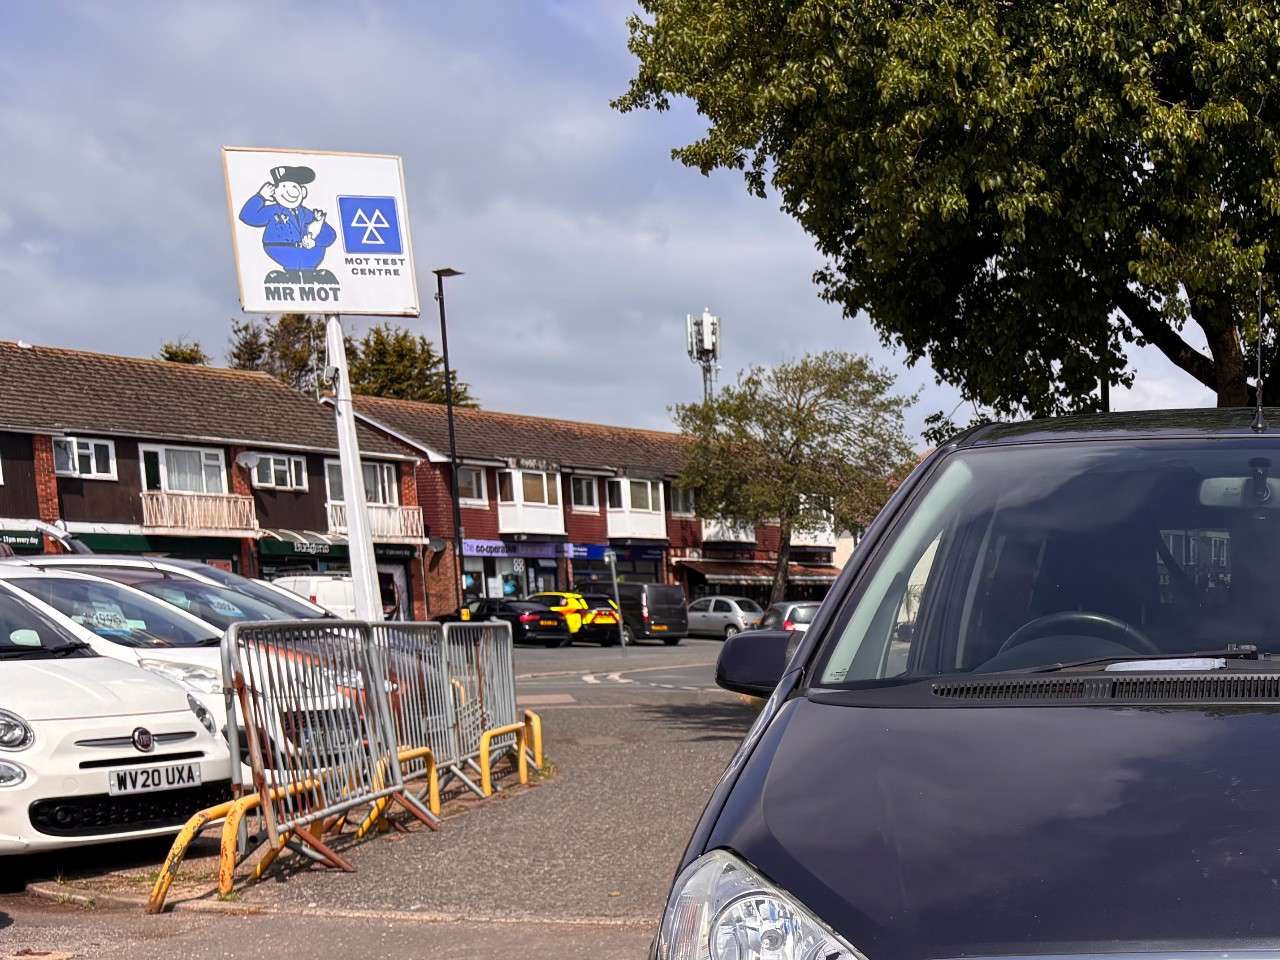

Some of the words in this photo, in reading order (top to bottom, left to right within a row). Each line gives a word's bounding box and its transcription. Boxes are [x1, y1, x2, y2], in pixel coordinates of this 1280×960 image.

[344, 257, 371, 266] MOT
[374, 257, 406, 266] TEST
[351, 267, 401, 277] CENTRE
[264, 286, 296, 301] MR
[299, 286, 341, 302] MOT
[116, 769, 162, 791] WV20
[165, 765, 195, 785] UXA
